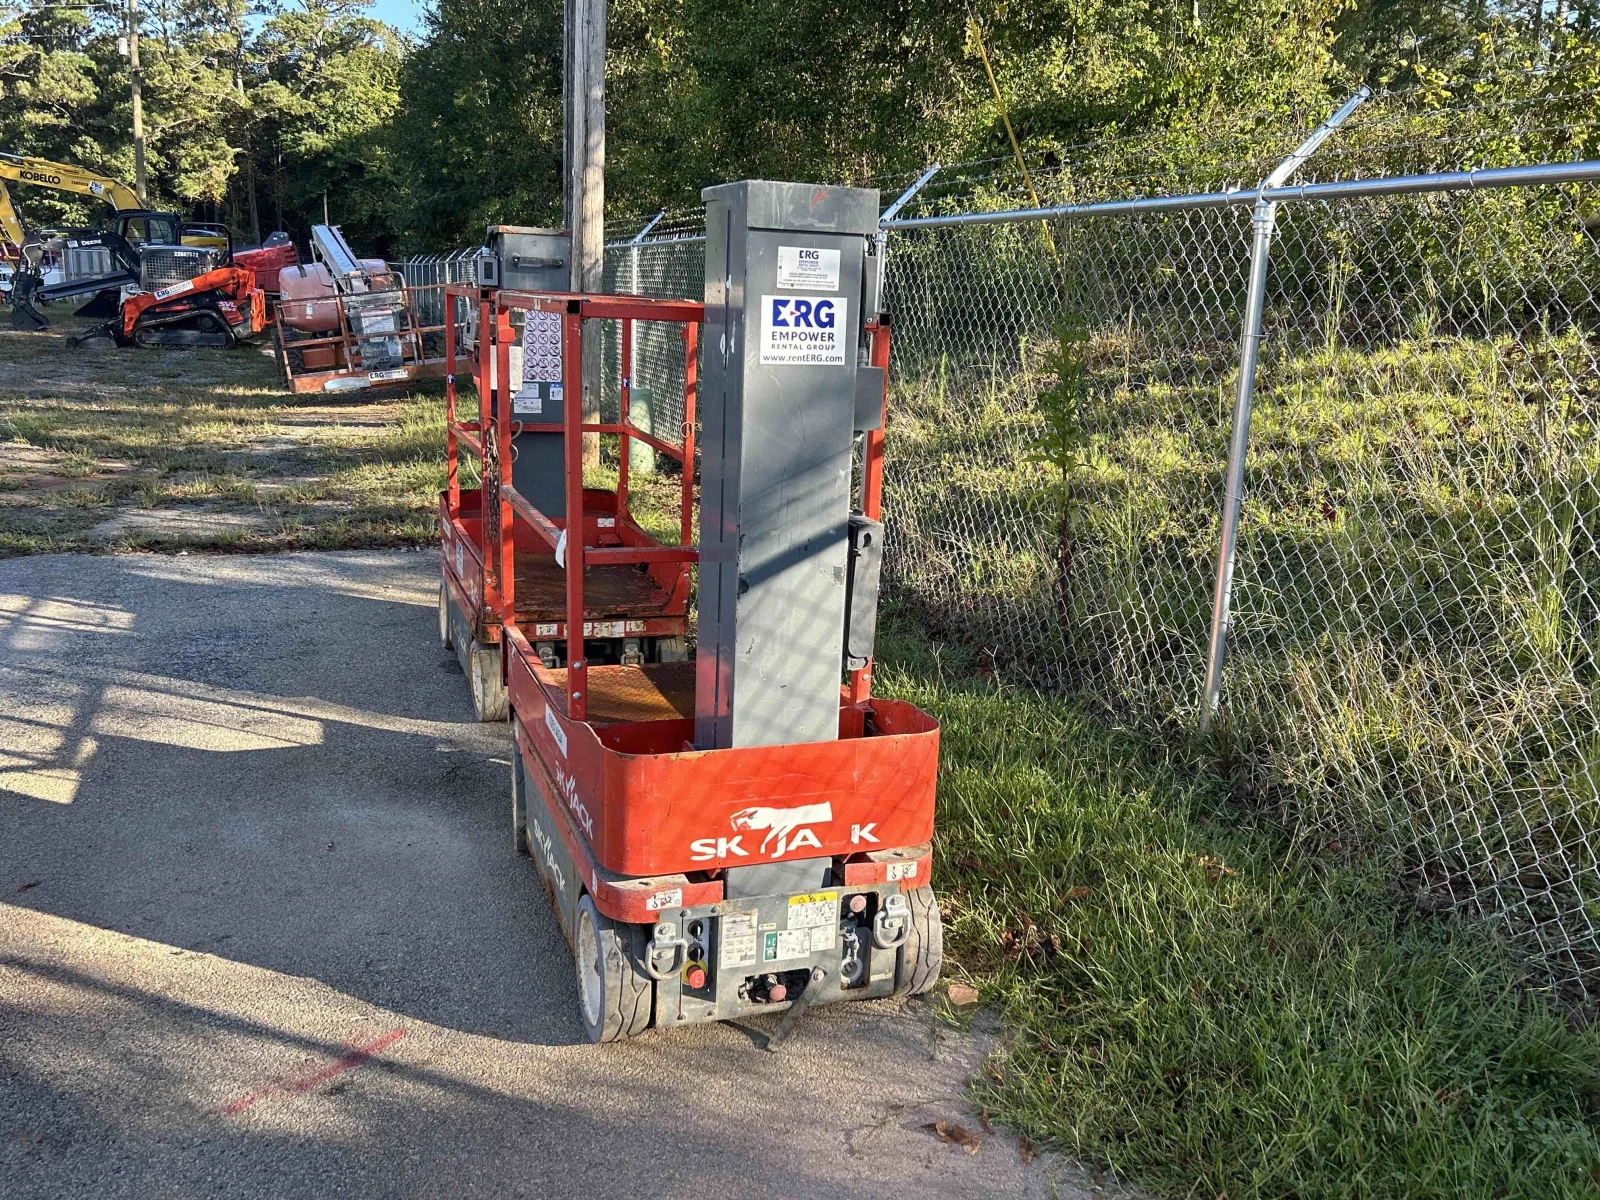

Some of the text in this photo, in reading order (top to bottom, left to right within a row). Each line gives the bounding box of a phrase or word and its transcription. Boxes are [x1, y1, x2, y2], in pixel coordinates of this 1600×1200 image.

[20, 170, 60, 185] KOBELCO
[799, 250, 819, 260] ERG
[156, 288, 170, 299] ERG
[772, 299, 835, 329] ERG
[771, 331, 835, 342] EMPOWER
[763, 353, 843, 363] www.rentERG.com
